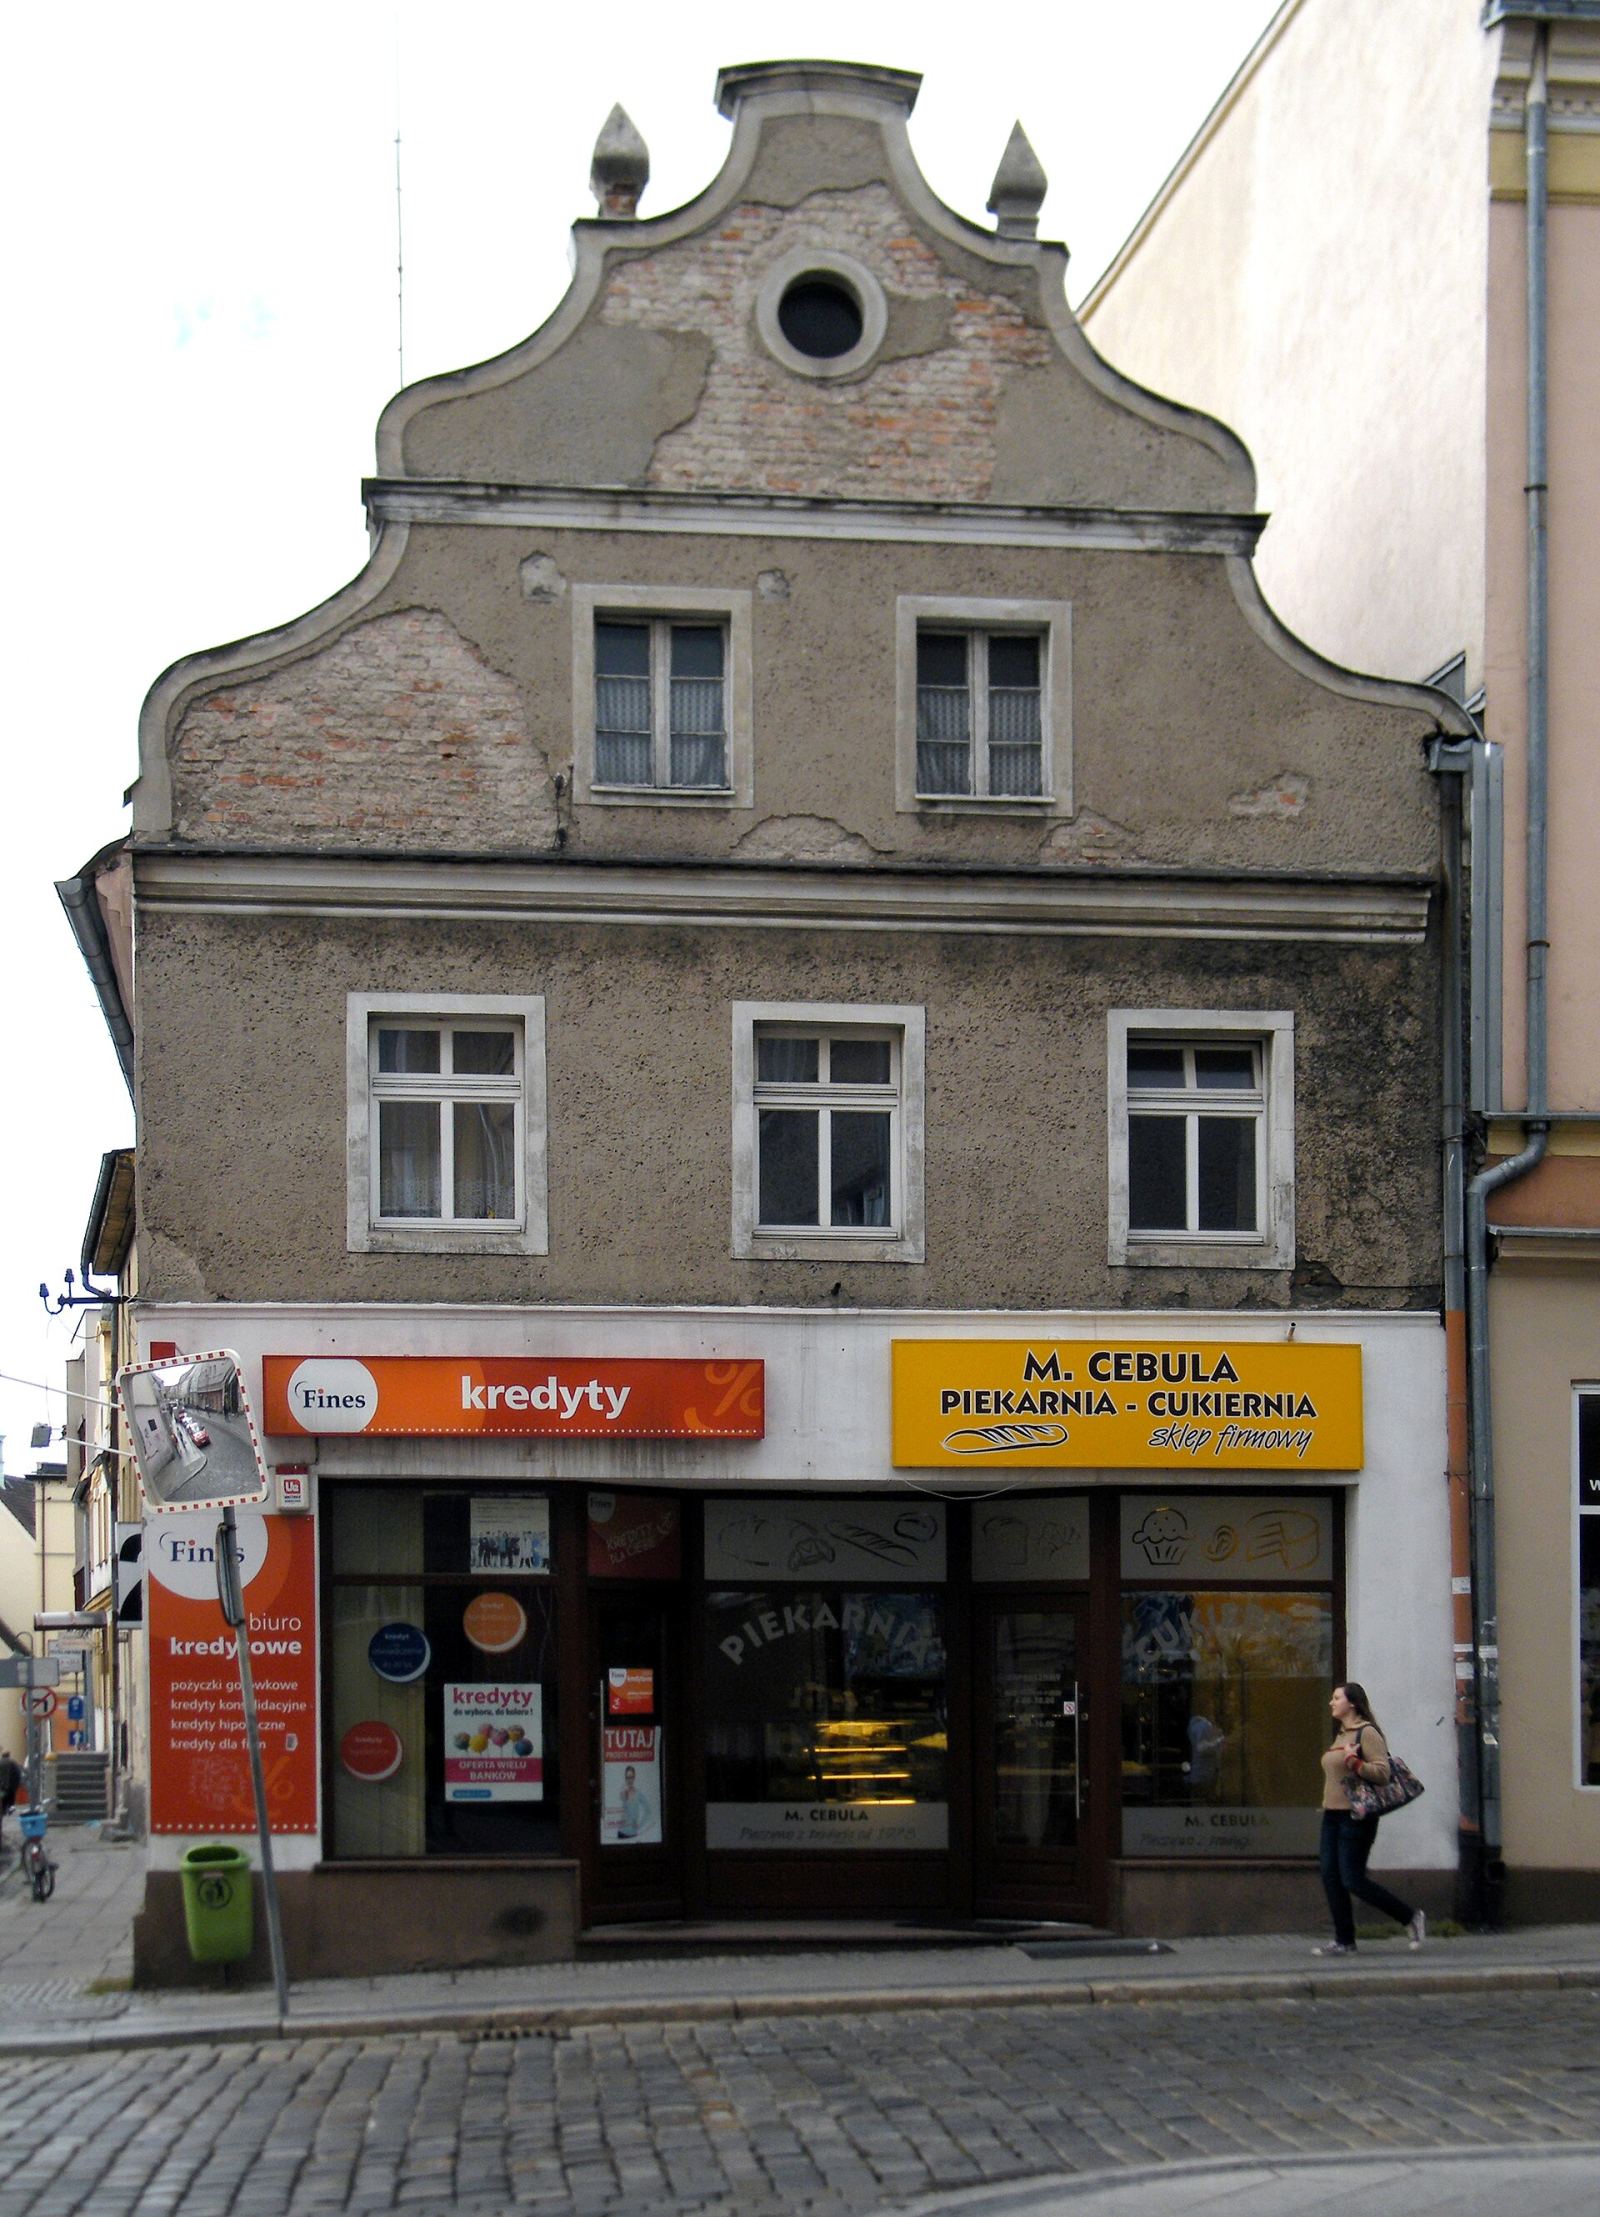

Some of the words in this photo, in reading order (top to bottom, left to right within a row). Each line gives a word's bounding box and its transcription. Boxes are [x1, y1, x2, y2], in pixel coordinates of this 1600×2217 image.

[1023, 1349, 1074, 1383] M.
[1088, 1351, 1240, 1384] CEBULA
[301, 1387, 366, 1410] Fines
[461, 1375, 632, 1420] kredyty
[940, 1389, 1119, 1416] PIEKARNIA
[1147, 1391, 1318, 1418] CUKIERNIA
[1148, 1422, 1212, 1456] sklep
[1213, 1424, 1315, 1458] firmowy
[169, 1539, 246, 1563] Fins
[249, 1612, 302, 1631] biuro
[170, 1636, 302, 1660] kredyowe
[171, 1679, 222, 1693] pożyczki
[226, 1679, 298, 1693] gowkowe
[171, 1699, 215, 1712] kredyty
[219, 1699, 307, 1714] konslidacyjne
[453, 1687, 533, 1708] kredyty
[171, 1719, 215, 1732] kredyty
[219, 1719, 286, 1733] hipoczne
[171, 1738, 215, 1751] kredyty
[219, 1738, 238, 1749] dla
[605, 1729, 654, 1749] TUTAJ
[459, 1760, 496, 1769] OFERTA
[497, 1760, 527, 1769] WIELU
[810, 1809, 869, 1822] CEBULA
[1210, 1814, 1270, 1827] CEBULA
